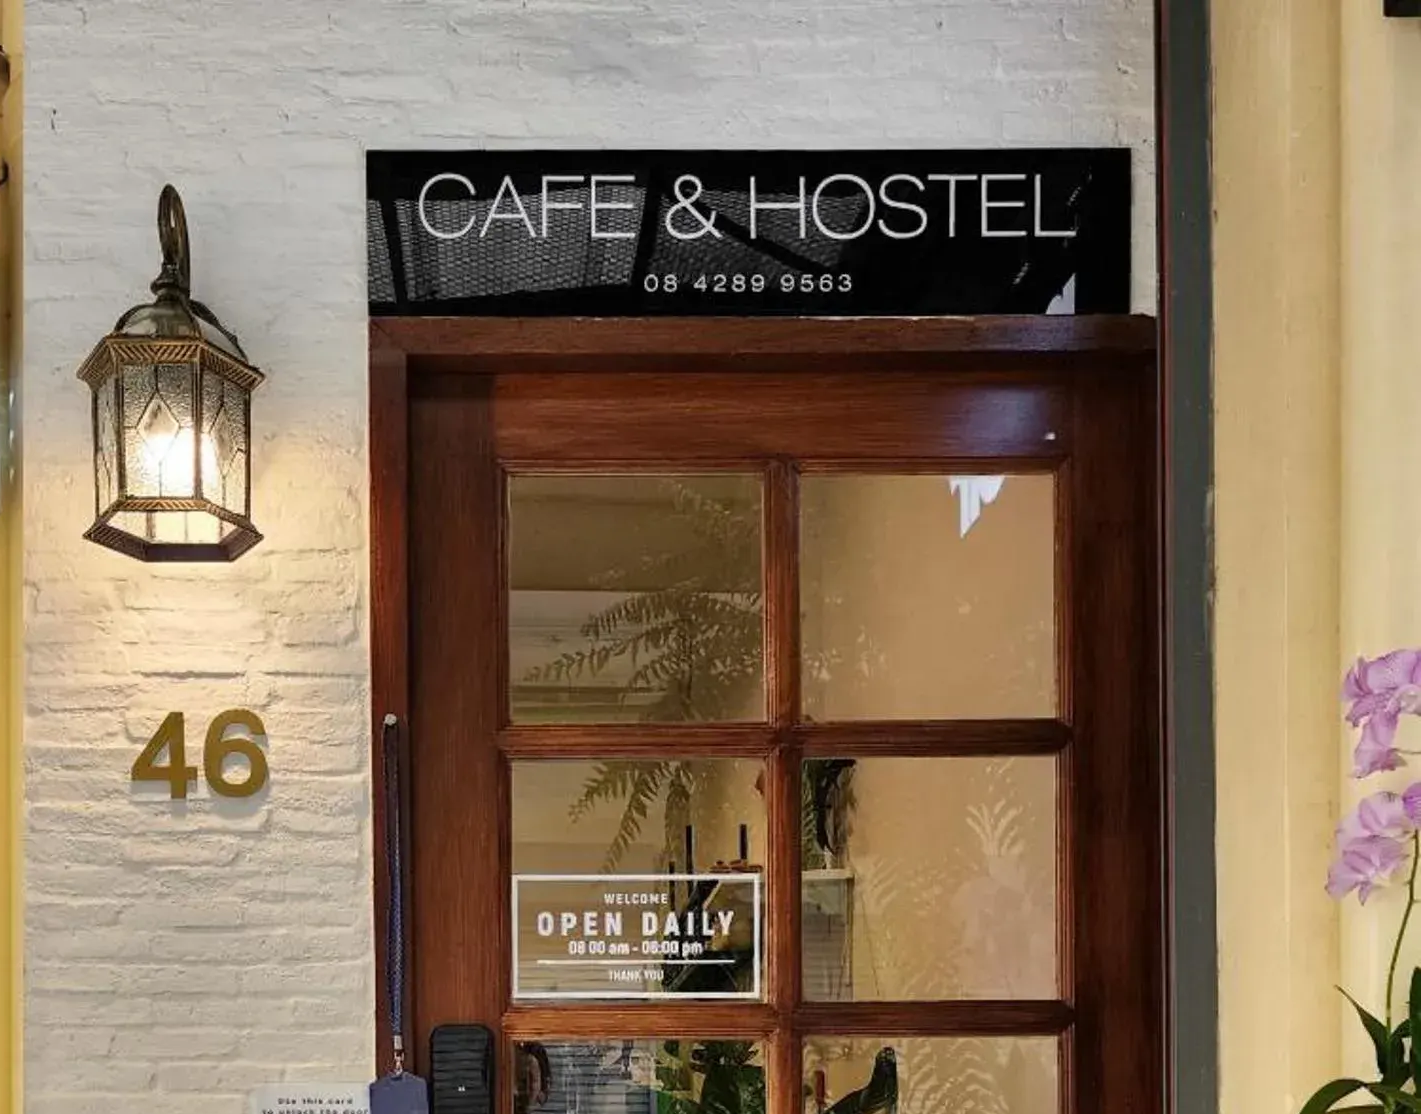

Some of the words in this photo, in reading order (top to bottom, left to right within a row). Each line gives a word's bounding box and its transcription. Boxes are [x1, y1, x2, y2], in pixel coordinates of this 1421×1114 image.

[418, 173, 636, 240] CAFE
[665, 174, 723, 240] &
[749, 173, 1077, 240] HOSTEL
[643, 273, 678, 293] 08
[692, 273, 766, 293] 4289
[779, 273, 853, 293] 9563
[130, 708, 268, 800] 46
[604, 893, 668, 905] WELCOME
[536, 911, 623, 937] OPEN
[641, 911, 735, 937] DAILY
[610, 969, 641, 982] THANK
[643, 968, 665, 981] YOU
